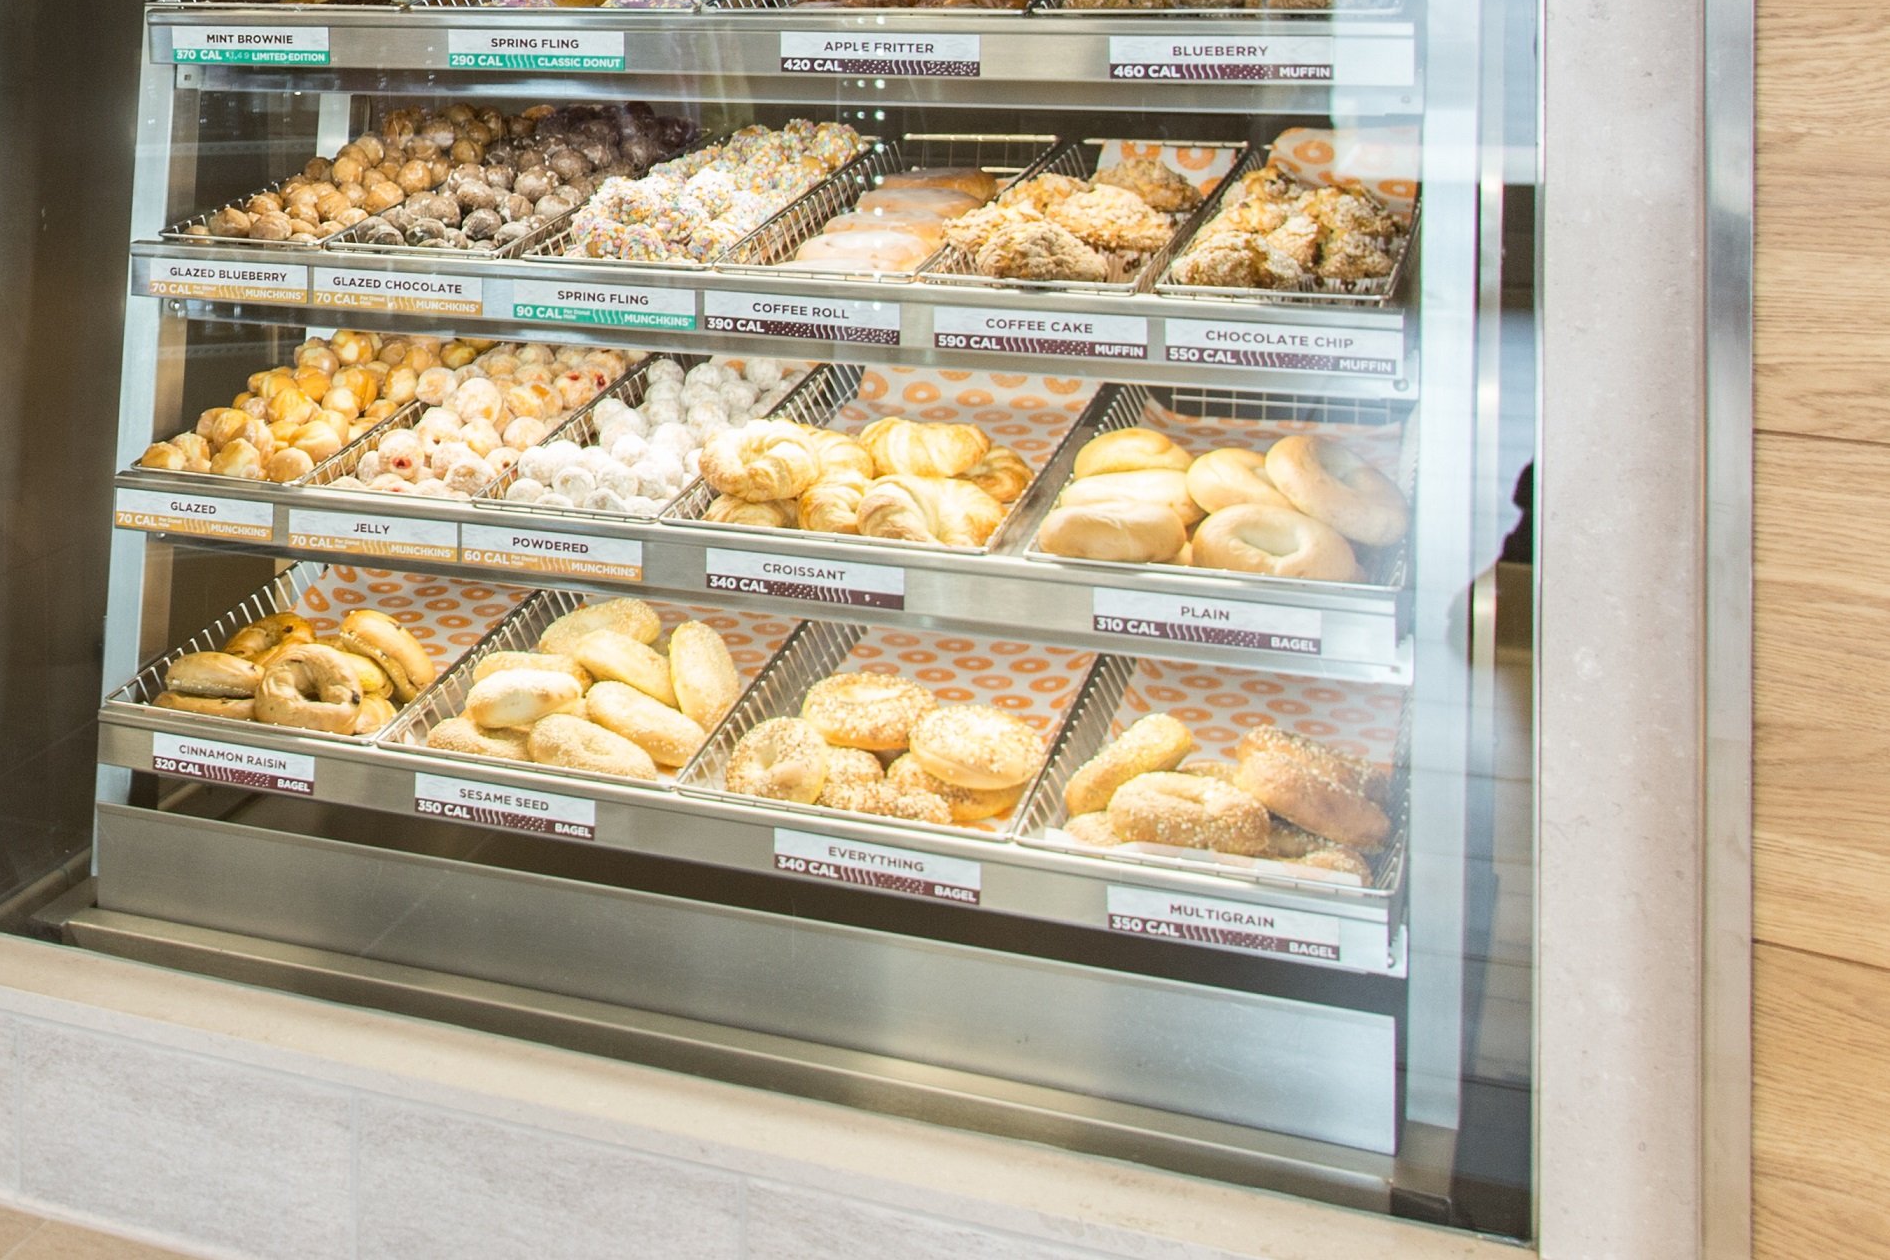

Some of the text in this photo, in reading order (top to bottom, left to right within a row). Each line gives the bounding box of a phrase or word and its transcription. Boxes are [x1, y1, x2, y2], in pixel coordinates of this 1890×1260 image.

[206, 34, 294, 44] MINT BROWNIE
[491, 38, 580, 50] SPRING FLING
[176, 50, 197, 60] 370
[200, 51, 223, 60] CAL
[824, 42, 935, 54] APPLE FRITTER
[1173, 46, 1269, 57] BLUEBERRY
[451, 55, 621, 68] 290 CAL CLASSIC DONUT
[784, 60, 842, 71] 420 CAL
[1114, 66, 1331, 78] 460 CAL MUFFIN
[169, 266, 288, 282] GLAZED BLUEBERRY
[152, 284, 166, 293] 70
[168, 284, 192, 295] CAL
[333, 276, 463, 294] GLAZED CHOCOLATE
[317, 293, 359, 305] 70 CAL
[558, 290, 650, 305] SPRING FLING
[516, 306, 562, 319] 90 CAL
[752, 303, 850, 320] COFFEE ROLL
[707, 317, 766, 333] 390 CAL
[986, 317, 1096, 334] COFFEE CAKE
[938, 334, 1144, 357] 590 CAL MUFFIN
[1206, 329, 1355, 349] CHOCOLATE CHIP
[1169, 347, 1393, 372] 550 CAL MUFFIN
[170, 501, 217, 514] GLAZED
[119, 513, 158, 525] 70 CAL
[354, 523, 391, 536] JELLY
[292, 535, 334, 548] 70 CAL
[512, 536, 589, 553] POWDERED
[465, 550, 510, 564] 60 CAL
[763, 563, 847, 581] CROISSANT
[710, 575, 769, 593] 340 CAL
[1180, 606, 1231, 621] PLAIN
[1097, 616, 1318, 651] 310 CAL BAGEL
[179, 745, 287, 770] CINNAMON RAISIN
[155, 758, 310, 791] 320 CAL BAGEL
[460, 788, 550, 811] SESAME SEED
[419, 800, 592, 836] 350 CAL BAGEL
[828, 846, 925, 873] EVERYTHING
[778, 855, 977, 901] 340 CAL BAGEL
[1170, 903, 1276, 929] MULTIGRAIN
[1112, 915, 1337, 959] 350 CAL BAGEL
